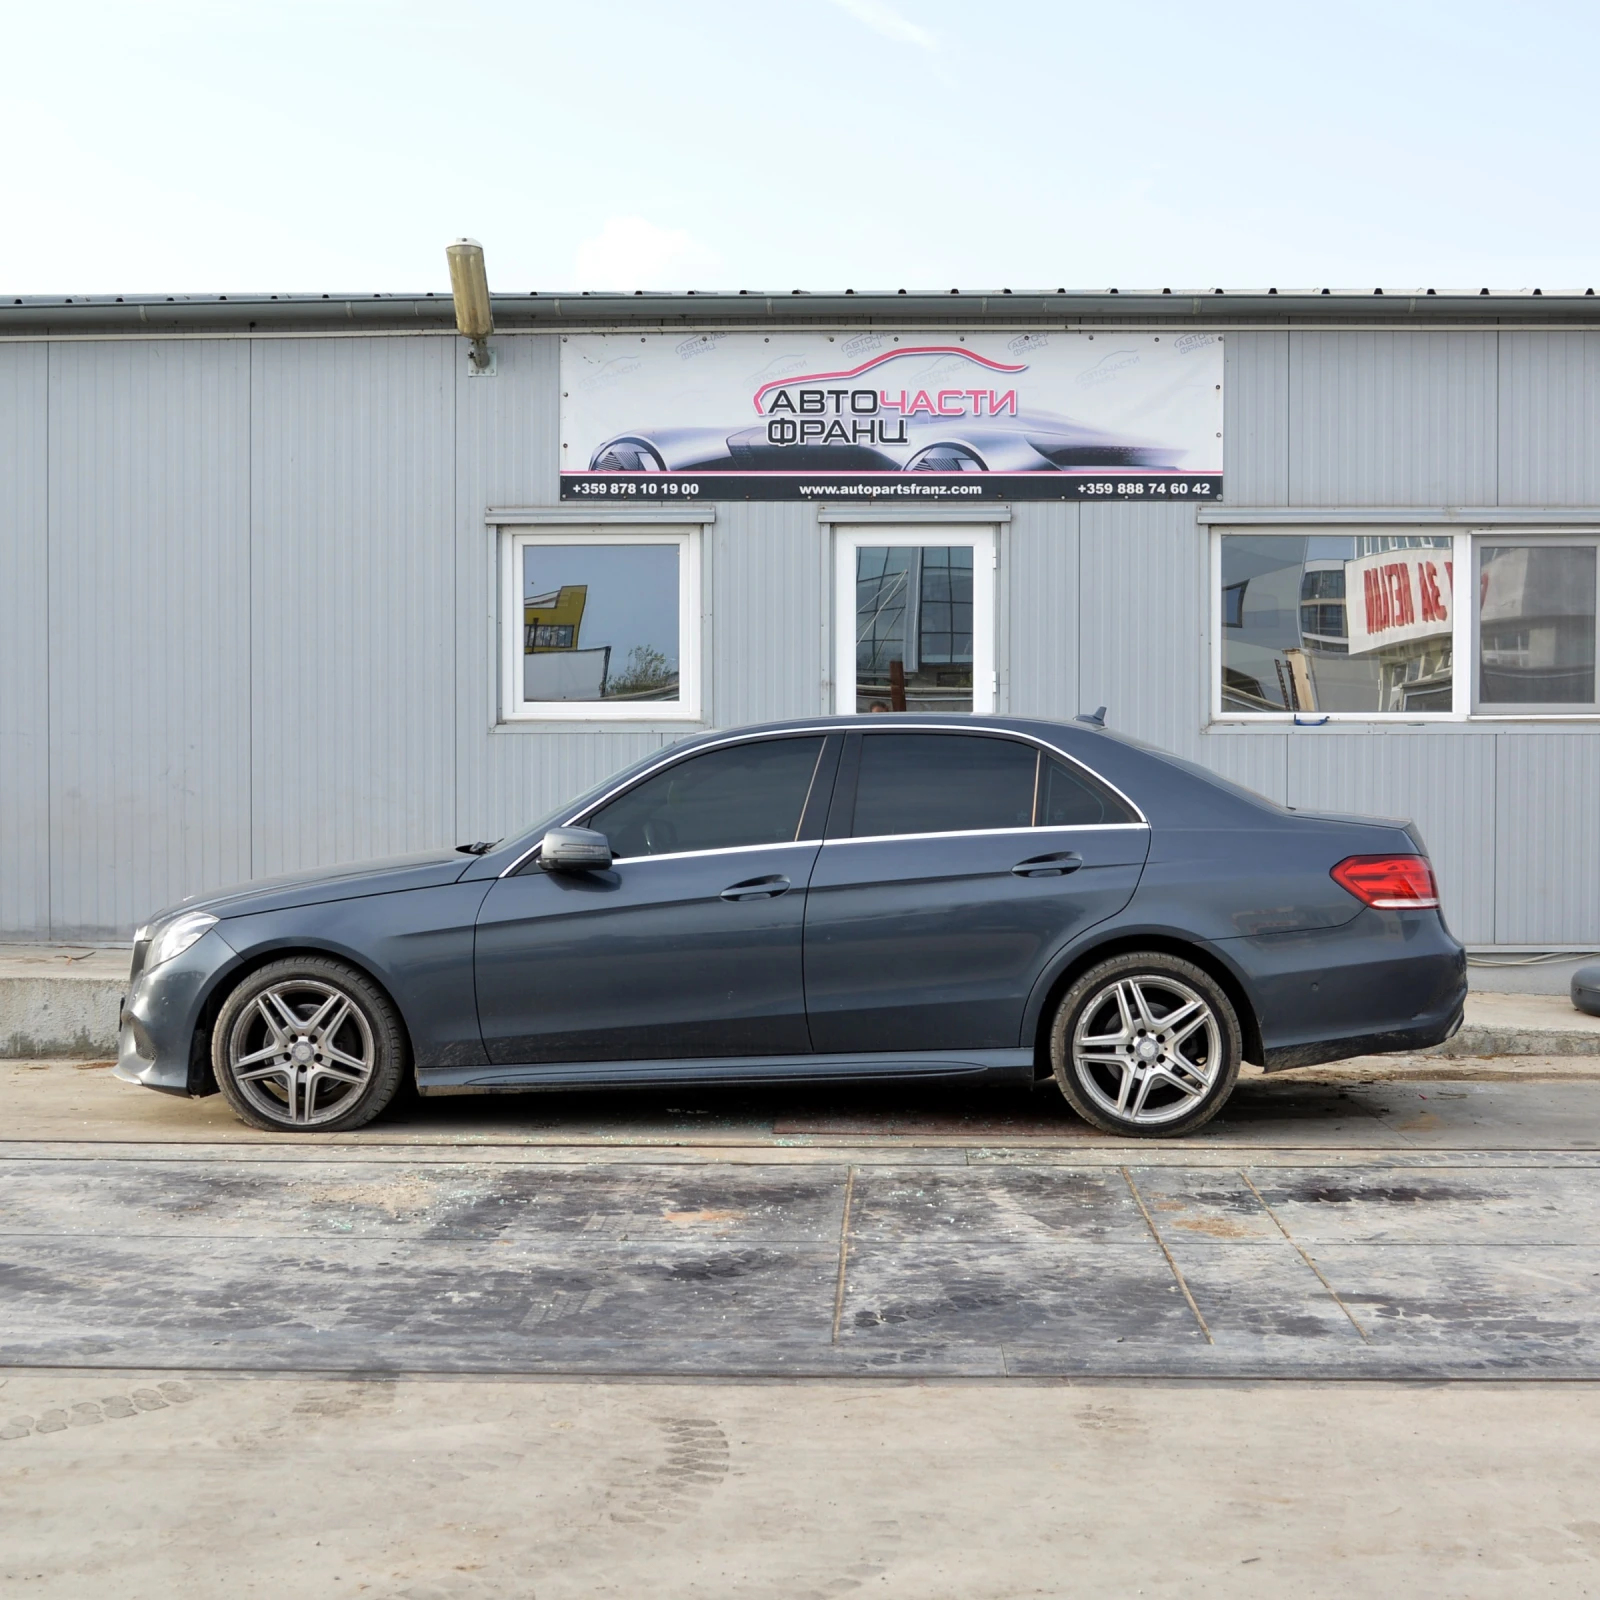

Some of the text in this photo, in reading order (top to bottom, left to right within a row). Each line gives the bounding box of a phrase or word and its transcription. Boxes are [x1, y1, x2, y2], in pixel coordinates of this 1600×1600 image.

[767, 389, 1016, 415] АВТОЧАСТИ
[767, 417, 908, 445] ФРАНЦ
[573, 483, 699, 494] +359 878 10 19 00
[799, 484, 982, 497] www.autopartsfranz.com
[1078, 483, 1210, 494] +359 888 74 60 42
